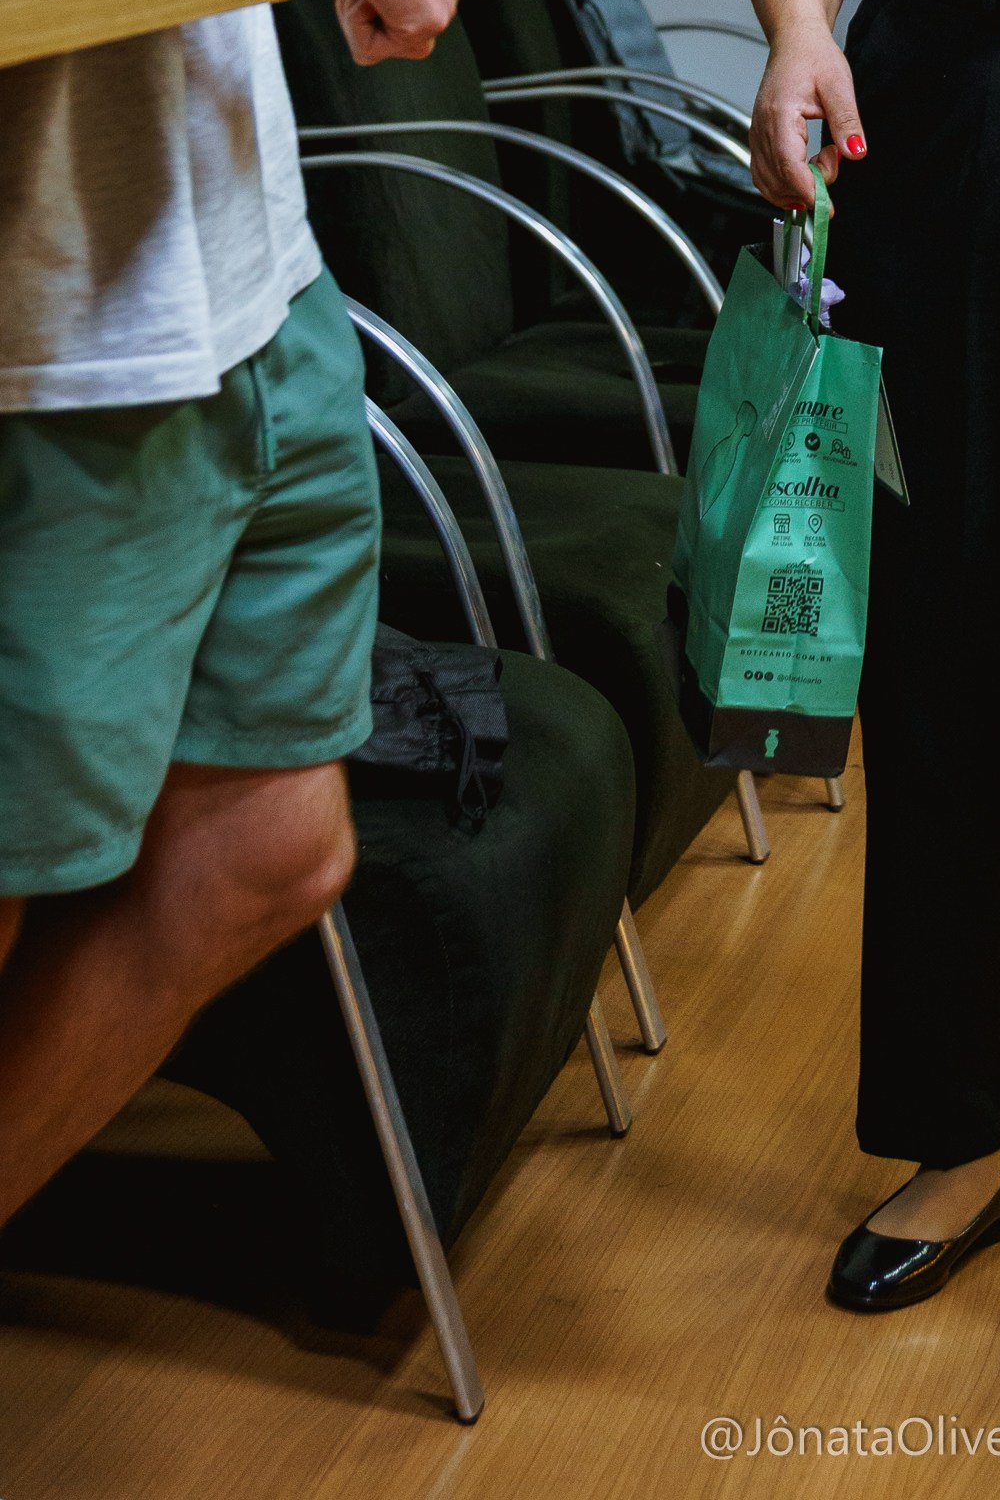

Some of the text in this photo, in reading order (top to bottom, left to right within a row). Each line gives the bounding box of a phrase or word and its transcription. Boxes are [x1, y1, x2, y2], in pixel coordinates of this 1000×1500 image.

[796, 401, 845, 420] mpre
[768, 476, 840, 499] escolha
[769, 499, 833, 508] COMO RECEBER
[740, 649, 832, 662] BOTICARIO.COM.BR
